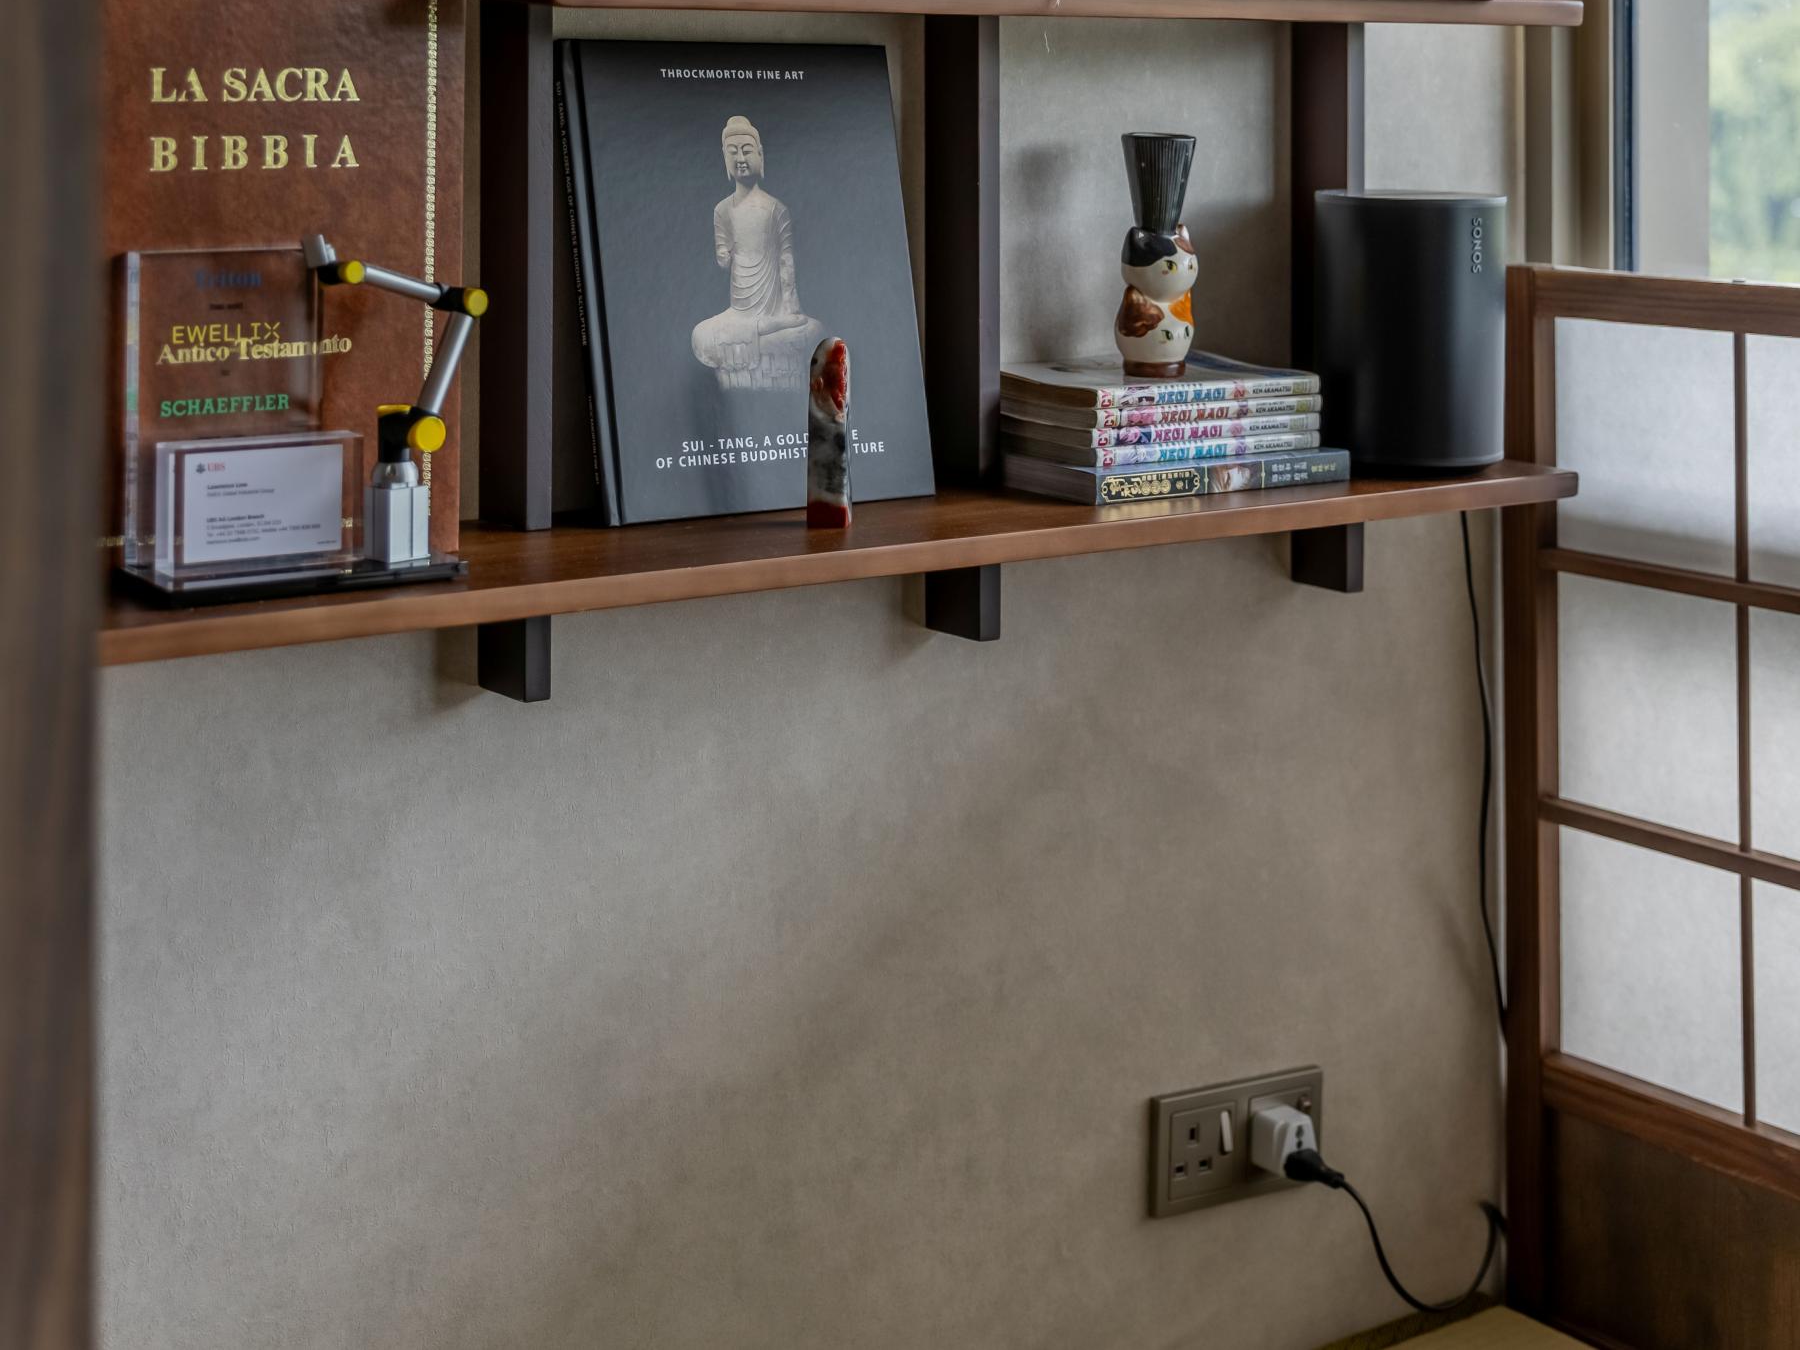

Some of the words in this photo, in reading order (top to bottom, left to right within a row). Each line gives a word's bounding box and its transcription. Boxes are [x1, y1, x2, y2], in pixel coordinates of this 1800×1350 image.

[150, 67, 208, 102] LA
[223, 67, 360, 102] SACRA
[660, 68, 753, 79] THROCKMORTON
[756, 70, 781, 80] FINE
[784, 71, 804, 80] ART
[150, 134, 360, 172] BIBBIA
[1472, 217, 1482, 274] SONOS
[172, 321, 281, 345] EWELLIX
[156, 342, 231, 365] Antico
[160, 394, 290, 418] SCHAEFFLER
[682, 440, 704, 453] SUI
[718, 437, 759, 451] TANG,
[763, 436, 771, 446] A
[776, 433, 809, 445] GOLD
[656, 457, 673, 469] OF
[679, 454, 736, 468] CHINESE
[741, 448, 808, 462] BUDDHIST
